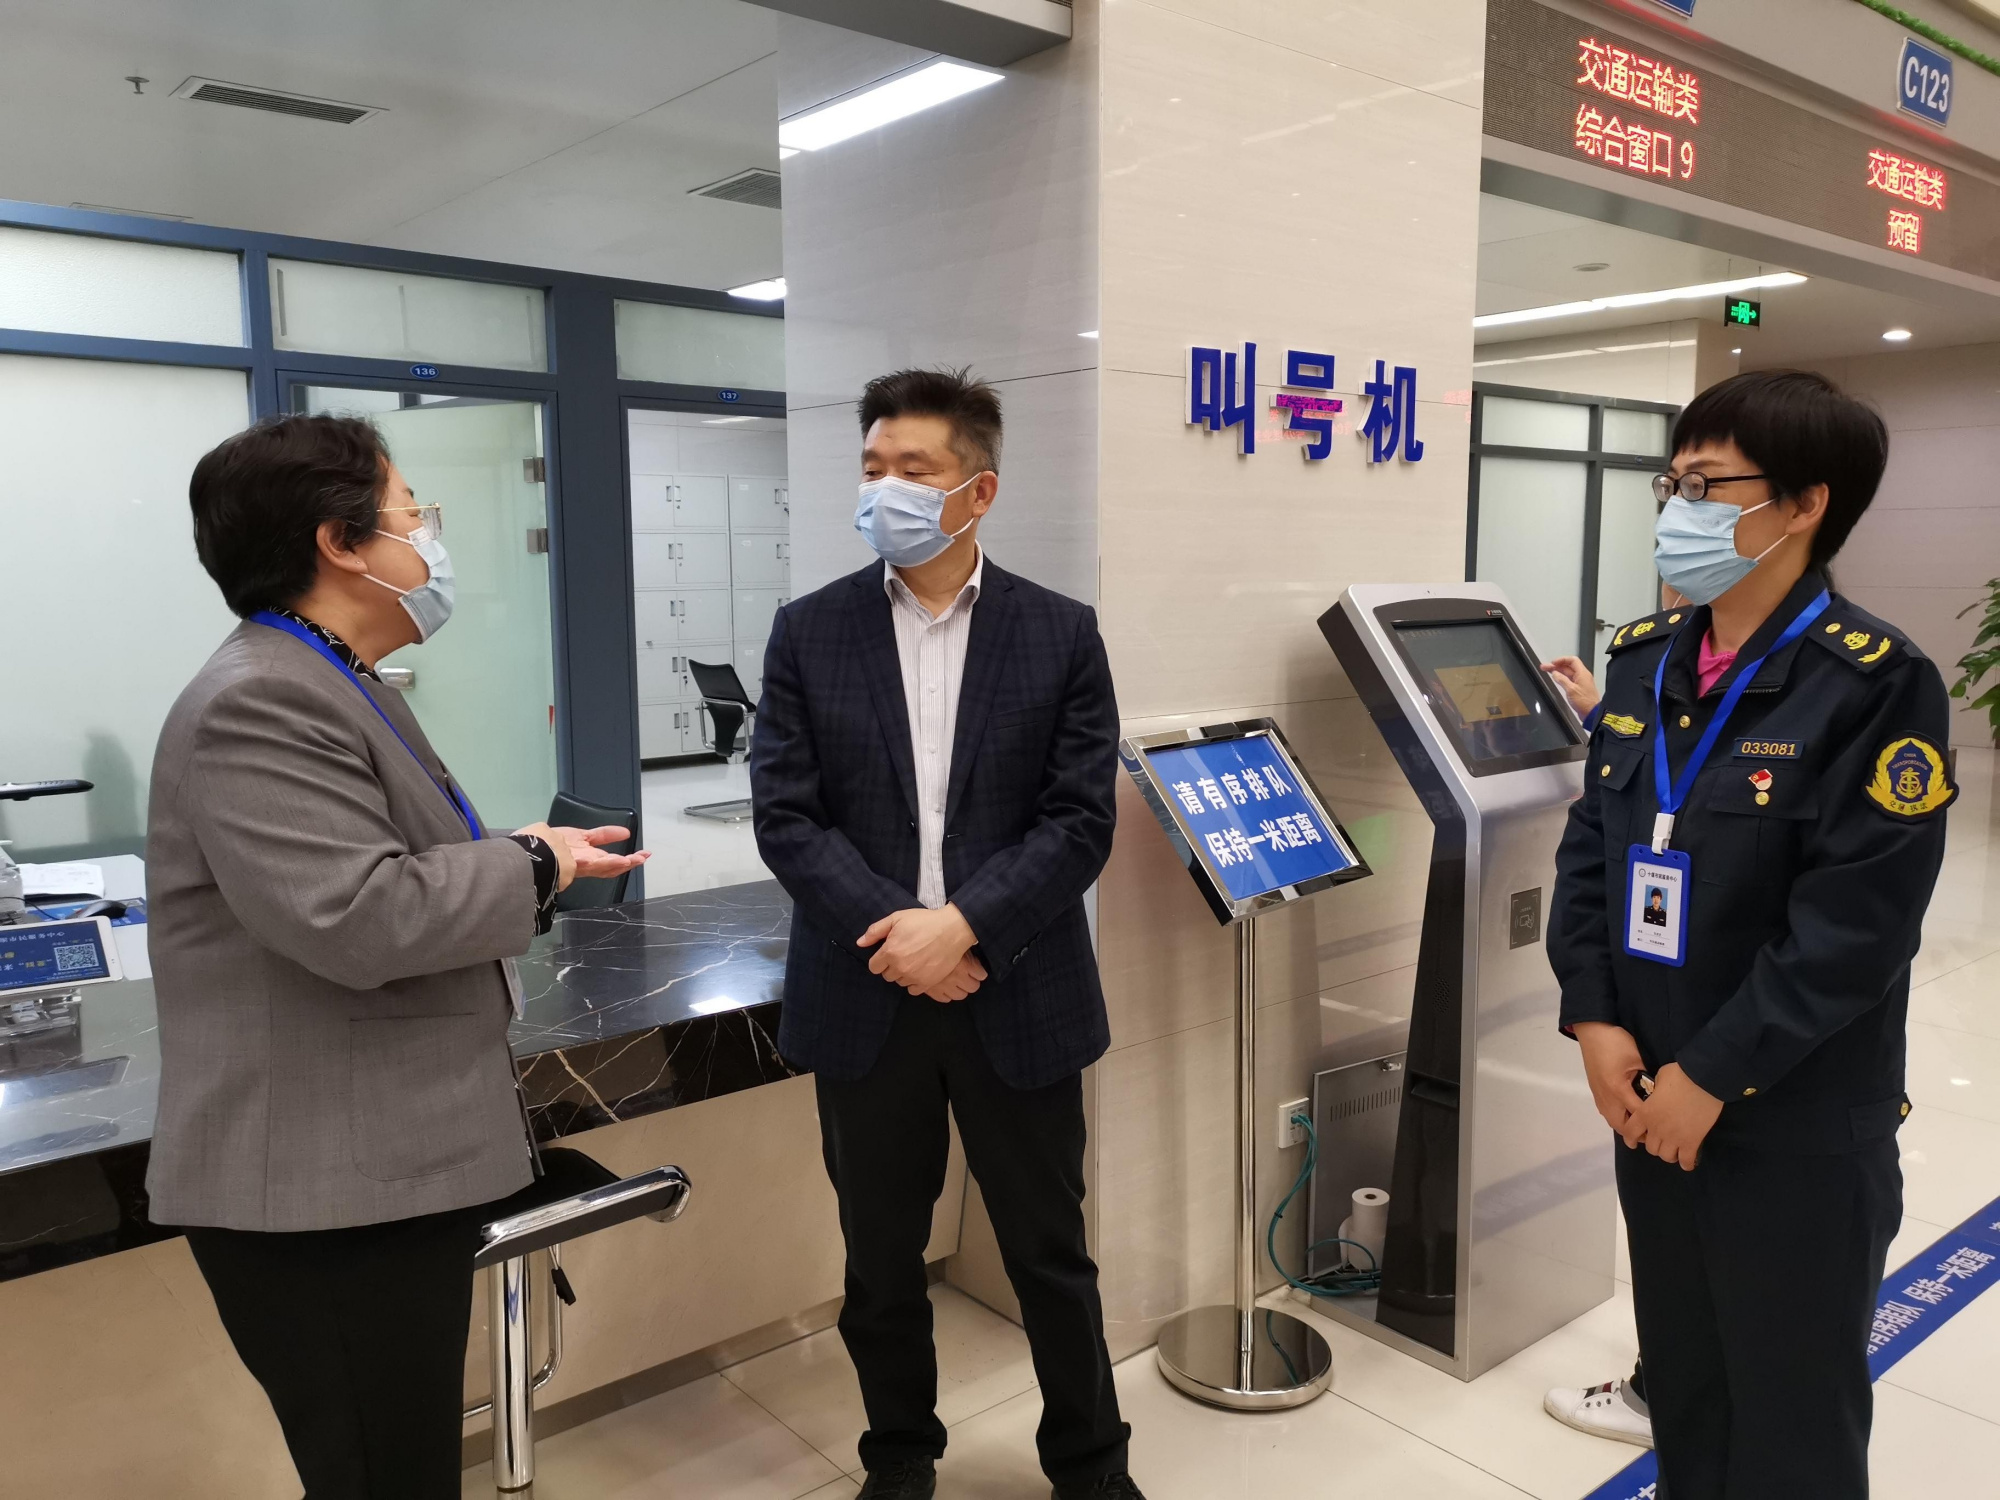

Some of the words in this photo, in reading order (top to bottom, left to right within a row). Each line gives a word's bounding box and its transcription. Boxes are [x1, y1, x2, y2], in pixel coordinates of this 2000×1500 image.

[1576, 38, 1700, 124] 交通运输类
[1904, 56, 1950, 113] C123
[1575, 104, 1673, 178] 综合窗口
[1680, 142, 1694, 179] 9
[1866, 149, 1946, 211] 交通运输类
[1887, 209, 1921, 253] 预留
[413, 364, 437, 378] 136
[720, 390, 738, 401] 137
[1185, 341, 1425, 464] 叫号机
[1741, 741, 1796, 756] 033081
[1172, 764, 1292, 815] 请有序排队
[1204, 811, 1322, 868] 保持一米距离
[1902, 1247, 1996, 1305] 保持一米距离
